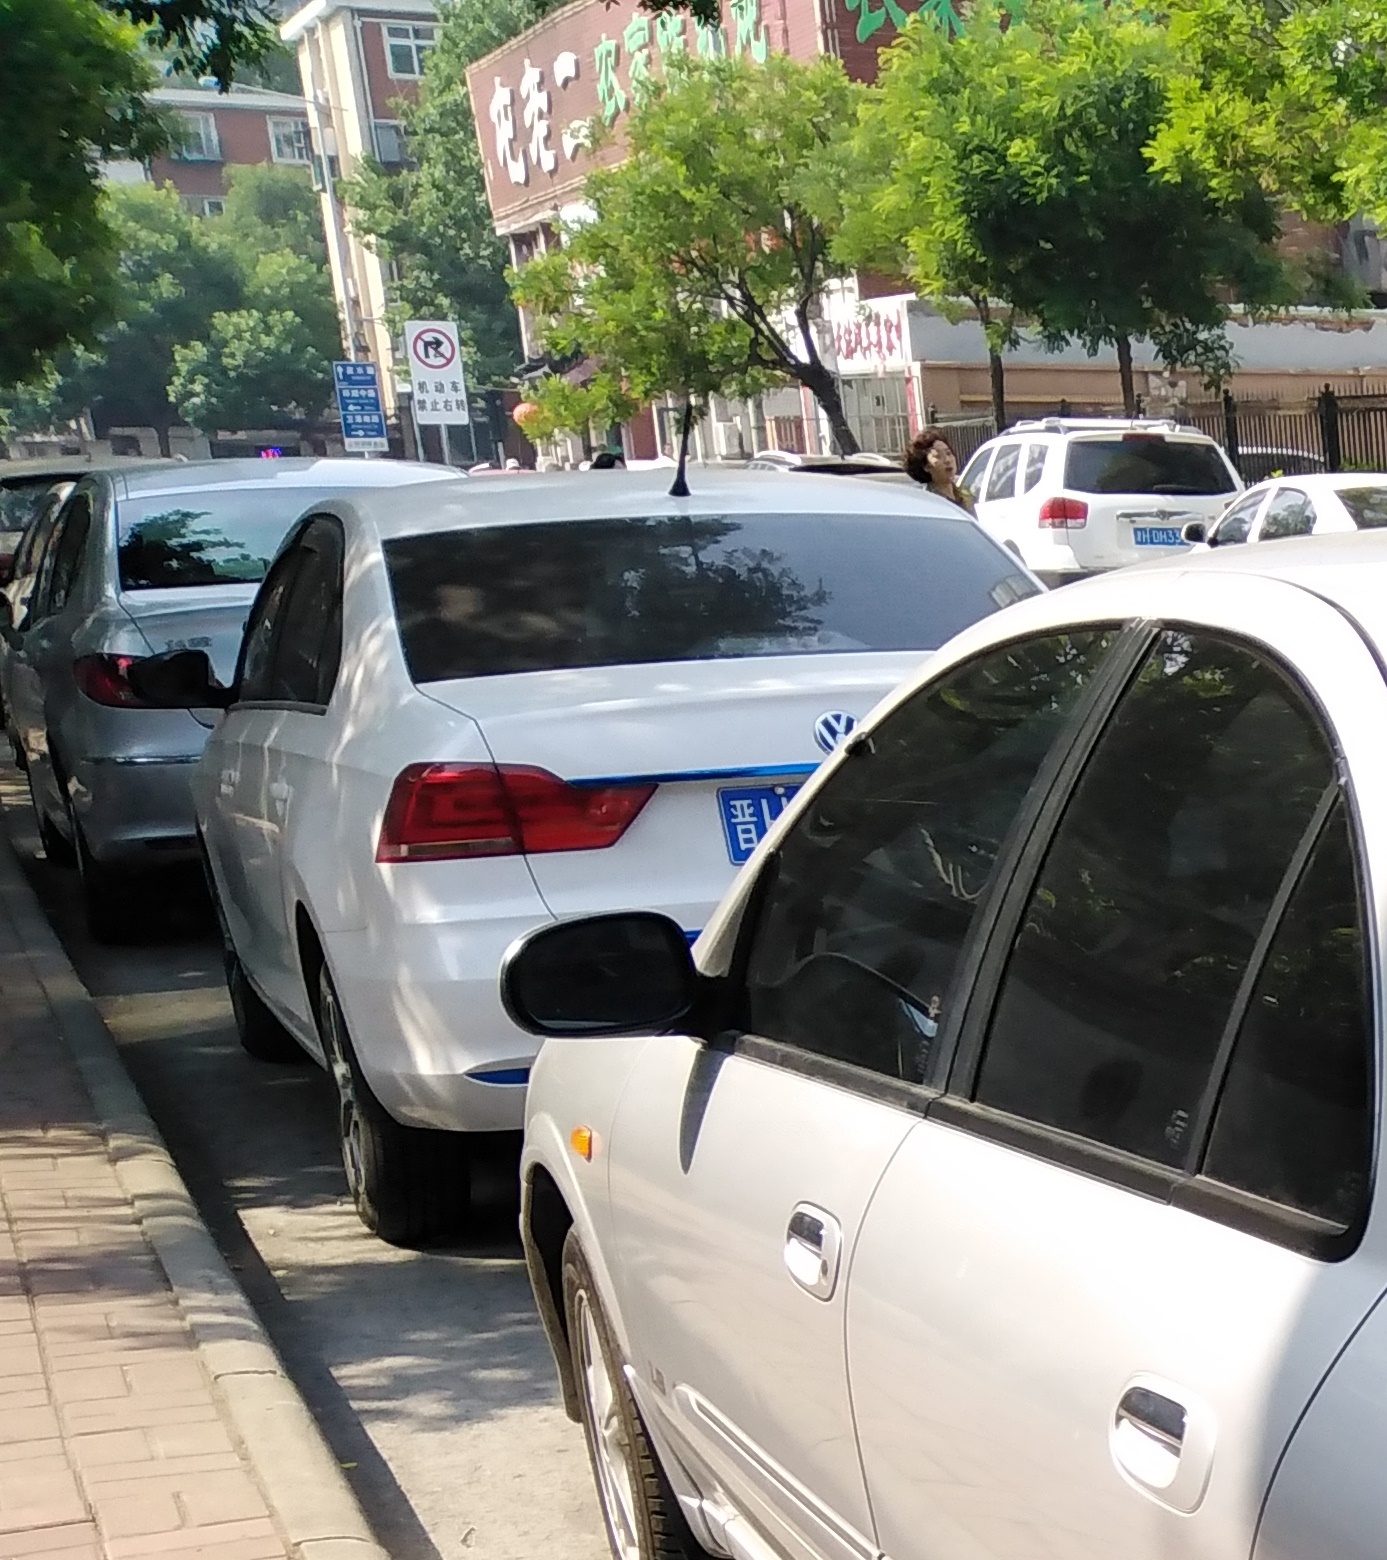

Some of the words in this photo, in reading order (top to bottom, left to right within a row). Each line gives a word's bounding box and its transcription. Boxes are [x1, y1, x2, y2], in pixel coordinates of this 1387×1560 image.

[417, 380, 463, 394] 机动车
[416, 398, 467, 413] 禁止右转
